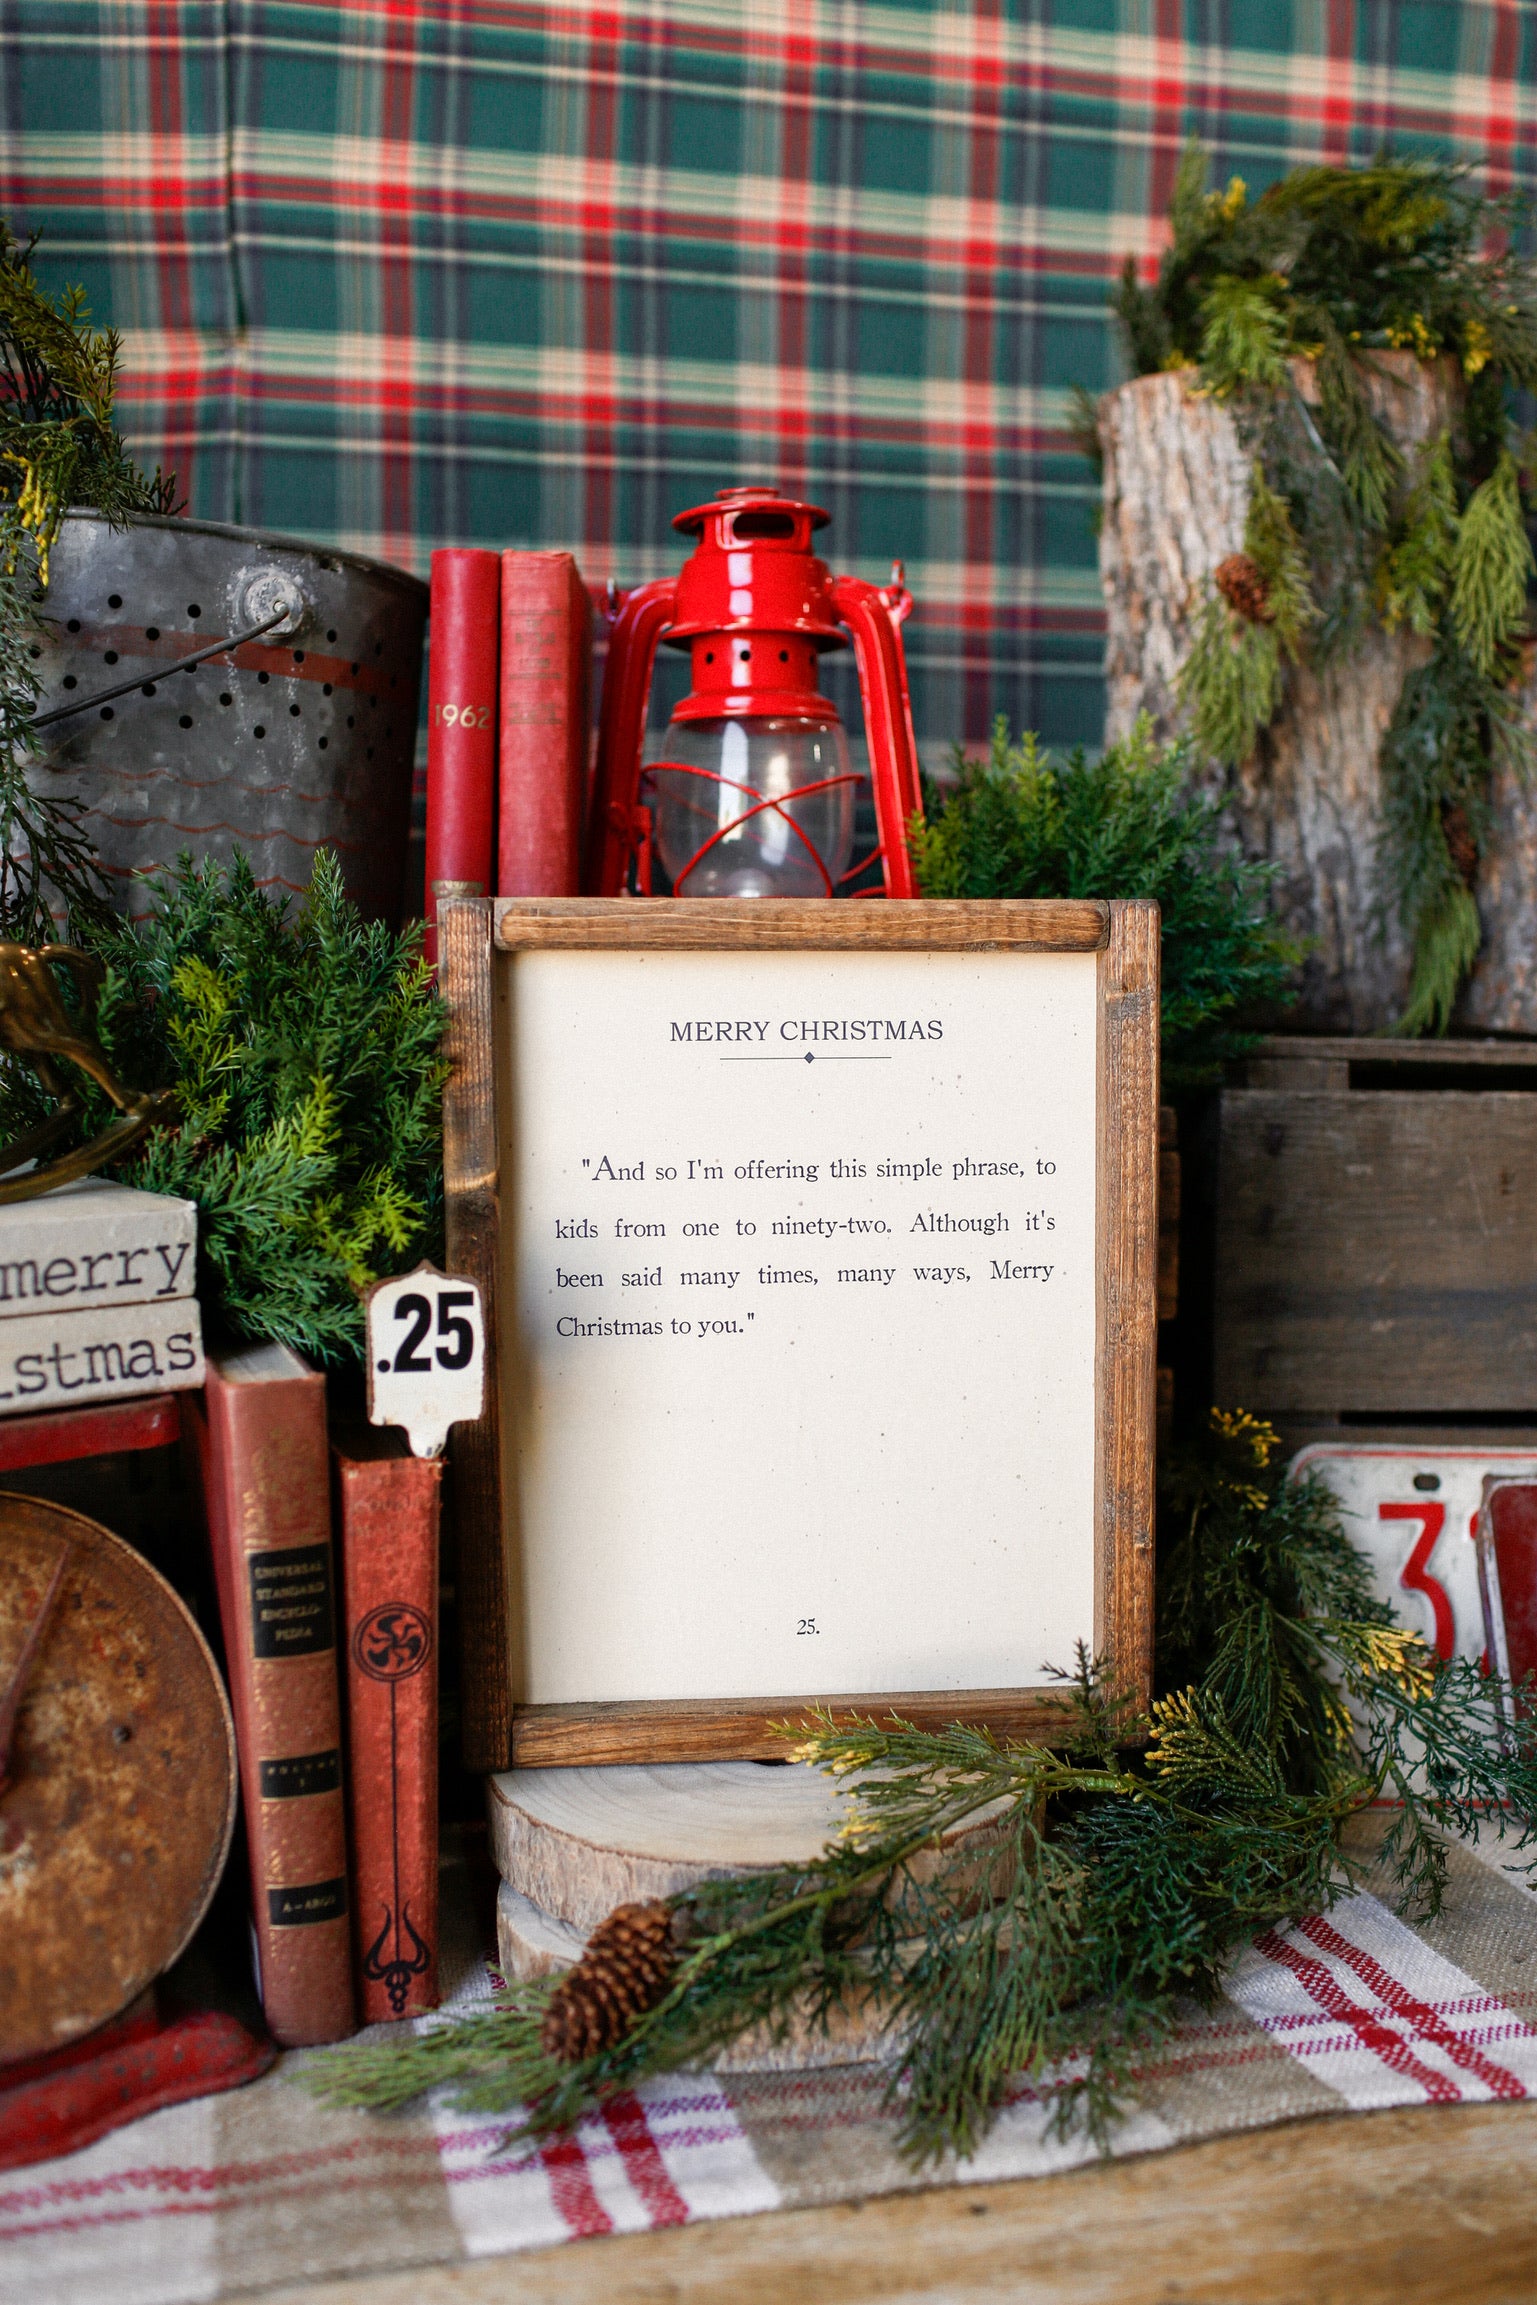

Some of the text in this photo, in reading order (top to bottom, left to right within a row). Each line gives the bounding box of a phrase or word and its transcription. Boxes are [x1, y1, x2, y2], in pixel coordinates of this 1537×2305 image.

[435, 703, 490, 729] 1962
[669, 1019, 944, 1042] MERRY CHRISTMAS
[582, 1155, 1057, 1183] "And so I'm offering this simple phrase, to
[554, 1209, 1056, 1239] kids from one to ninety-two. Although it's
[0, 1242, 190, 1300] merry
[555, 1259, 1055, 1289] been said many times, many ways, Merry
[377, 1290, 474, 1374] .25
[556, 1312, 755, 1338] Christmas to you."
[1378, 1502, 1490, 1677] 3
[796, 1617, 820, 1636] 25.
